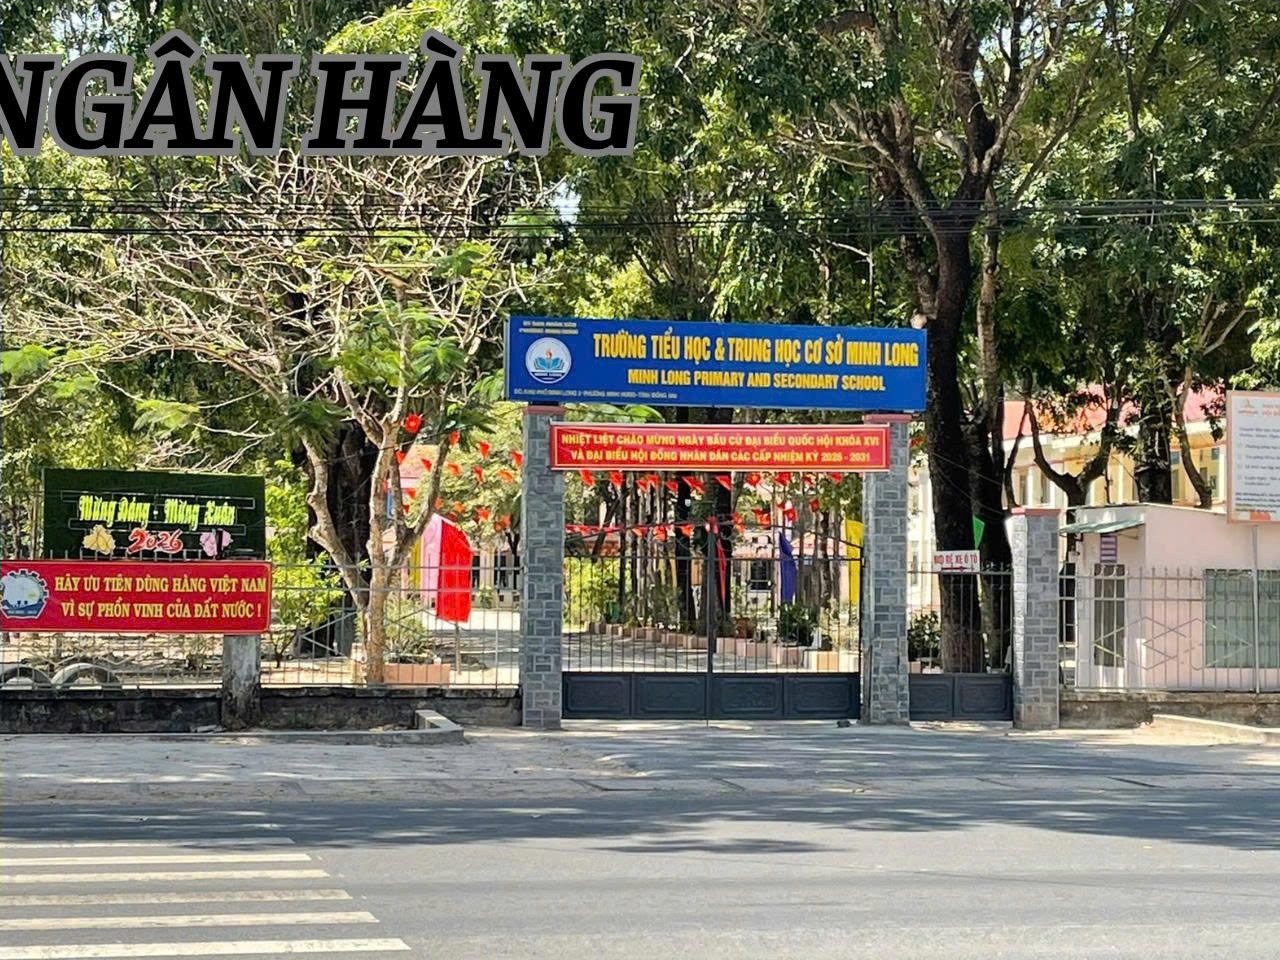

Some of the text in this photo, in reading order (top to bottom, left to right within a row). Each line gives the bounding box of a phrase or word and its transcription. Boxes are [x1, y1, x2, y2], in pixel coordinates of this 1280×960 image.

[593, 326, 919, 368] TRƯỜNG TIỂU HỌC & TRUNG HỌC CƠ SỞ MINH LONG
[628, 369, 886, 391] MINH LONG PRIMARY AND SECONDARY SCHOOL
[561, 432, 880, 449] NHIỆT LIỆT CHÀO MỪNG NGÀY BẦU CỬ ĐẠI BIỂU QUỐC HỘI KHÓA XVI
[571, 448, 585, 461] VÀ
[586, 450, 603, 463] ĐẠI
[605, 447, 628, 461] BIỂU
[631, 449, 648, 463] HỘI
[650, 448, 677, 461] ĐỒNG
[680, 449, 707, 461] NHÂN
[709, 450, 729, 462] DÂN
[731, 450, 750, 462] CÁC
[752, 448, 772, 462] CẤP
[773, 451, 803, 463] NHIỆM
[805, 450, 818, 461] KỲ
[79, 495, 117, 528] Mừng
[164, 498, 200, 531] Mừng
[203, 500, 235, 526] Xuân
[127, 527, 183, 555] 2026
[54, 573, 267, 595] HÃY ƯU TIÊN DÙNG HÀNG VIỆT NAM
[61, 600, 76, 617] VÌ
[78, 601, 95, 621] SỰ
[97, 597, 131, 618] PHỒN
[133, 601, 164, 618] VINH
[166, 598, 193, 618] CỦA
[194, 597, 219, 618] ĐẤT
[221, 598, 255, 618] NƯỚC
